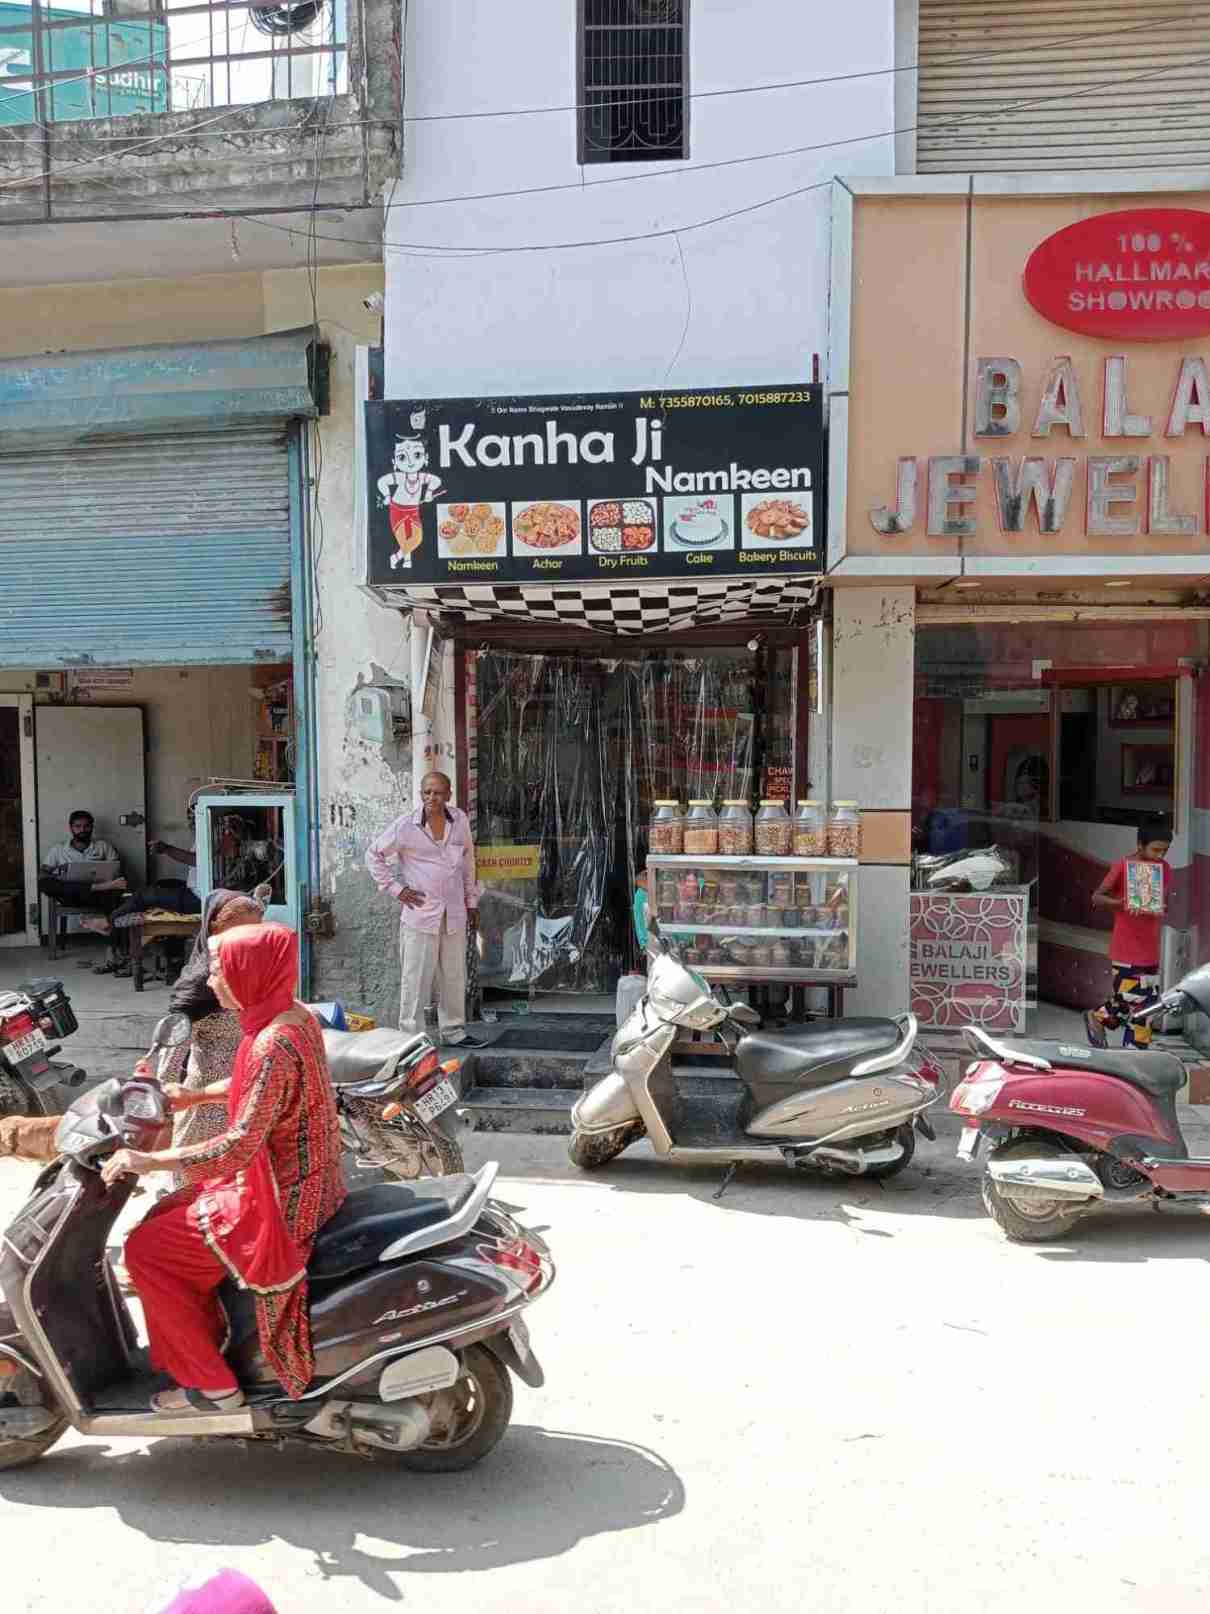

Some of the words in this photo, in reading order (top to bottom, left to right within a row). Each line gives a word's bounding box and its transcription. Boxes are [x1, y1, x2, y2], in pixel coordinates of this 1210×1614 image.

[1117, 233, 1162, 253] 100
[1170, 232, 1195, 252] %
[659, 394, 735, 409] 7355870165,
[738, 391, 811, 406] 7015887233
[974, 354, 1210, 439] BALA
[438, 420, 615, 467] Kanha
[631, 417, 662, 465] Ji
[645, 462, 812, 493] Namkeen
[868, 455, 1210, 536] JEWEL
[599, 555, 618, 569] Dry
[619, 554, 649, 567] Fruits
[685, 553, 713, 564] Cake
[738, 551, 777, 564] Bakery
[779, 549, 817, 561] Biscuits
[447, 559, 498, 572] Namkeen
[922, 943, 987, 960] BALAJI
[910, 963, 1011, 980] EWELLERS
